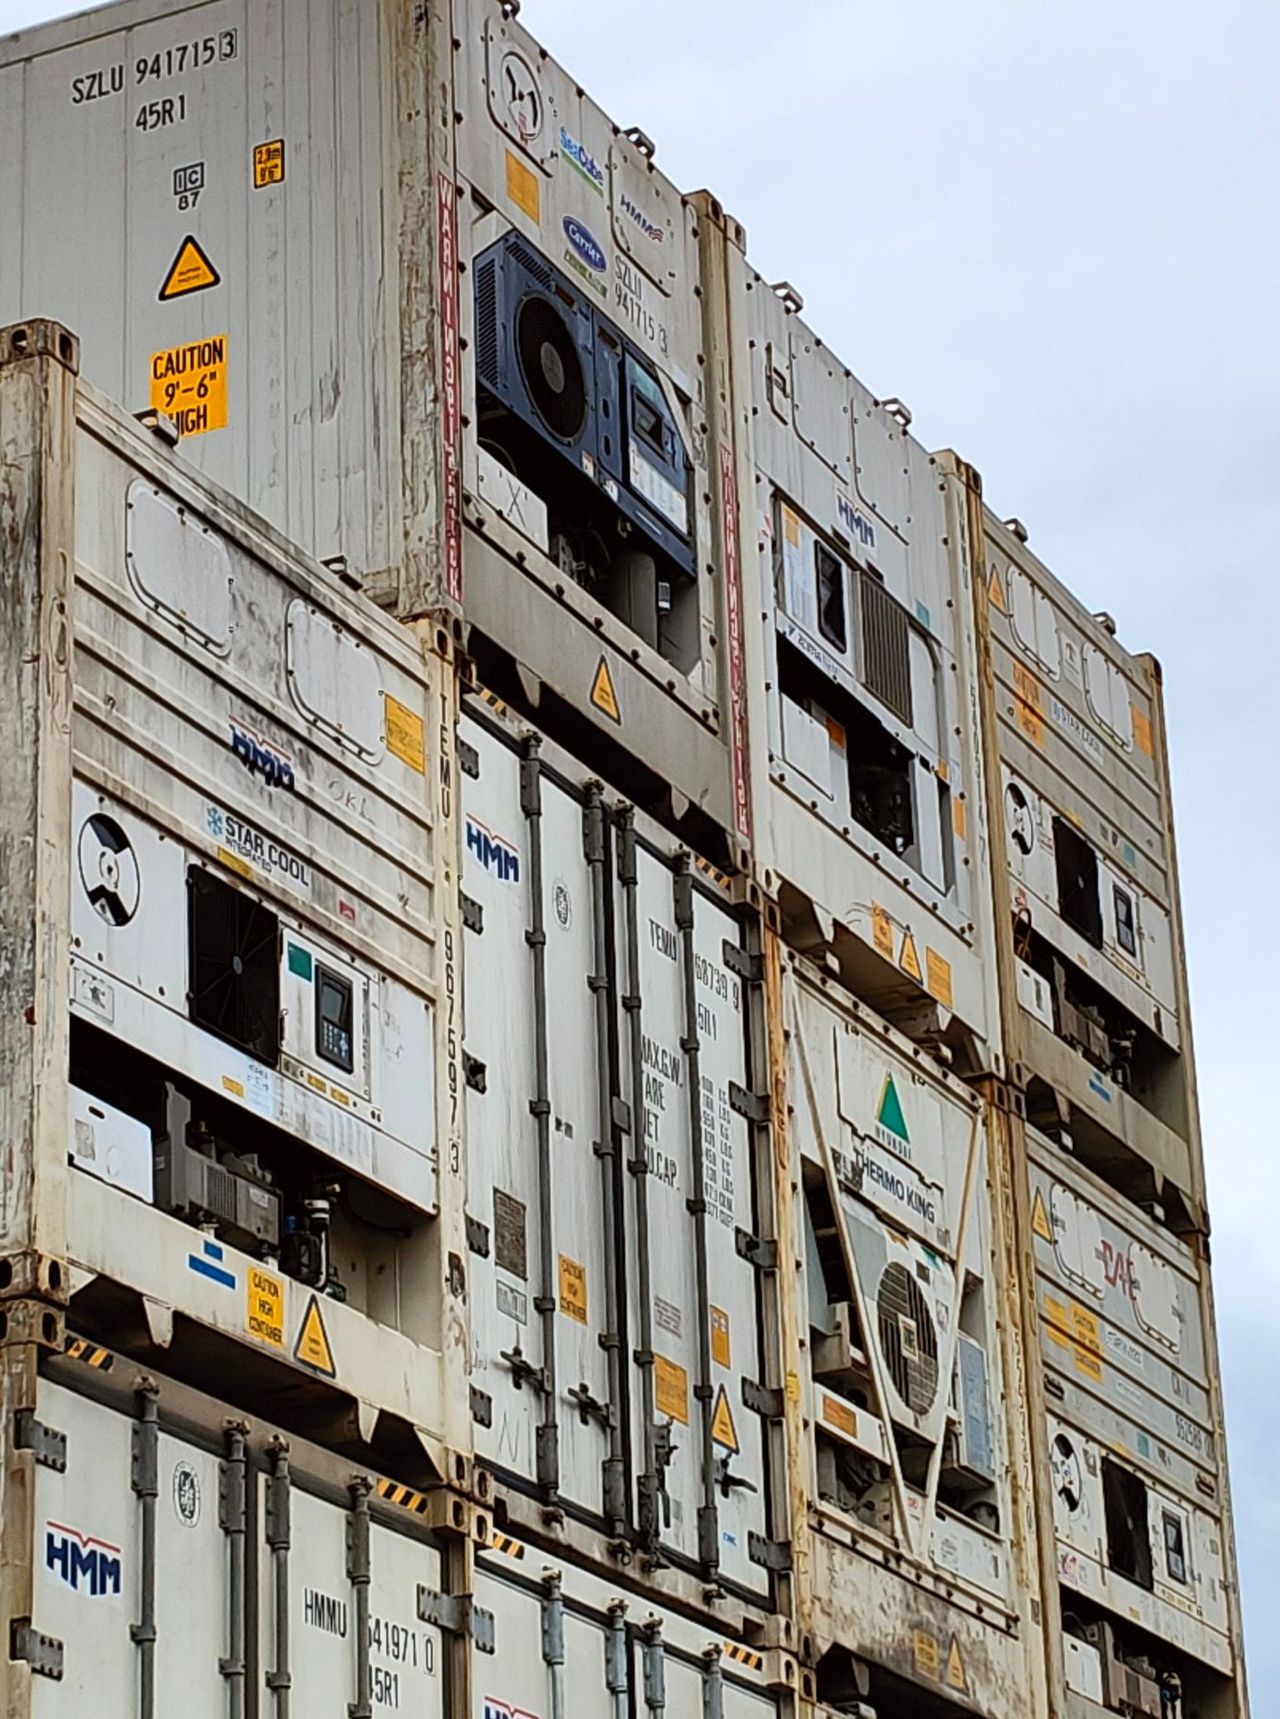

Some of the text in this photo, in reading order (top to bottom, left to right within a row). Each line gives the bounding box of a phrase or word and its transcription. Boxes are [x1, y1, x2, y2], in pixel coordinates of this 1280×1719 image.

[72, 31, 235, 103] SZLU 941715 3
[136, 95, 185, 131] 45R1
[178, 190, 200, 211] 87
[621, 193, 654, 237] HMM
[568, 224, 602, 264] Carrier
[438, 174, 455, 383] WARNING
[615, 255, 642, 300] SZLU
[615, 284, 655, 341] 941715
[153, 338, 223, 381] CAUTION
[837, 495, 875, 548] HMM
[440, 692, 451, 819] TEMU
[225, 816, 310, 887] STAR COOL
[225, 835, 273, 873] INTEGRATED
[467, 820, 519, 882] HMM
[648, 918, 677, 962] TEMU
[695, 952, 729, 1001] 68739
[445, 929, 459, 1127] 967597
[645, 1072, 666, 1111] ARE
[643, 1106, 660, 1142] ET
[853, 1147, 905, 1201] THERMO
[906, 1185, 935, 1225] KING
[253, 1272, 279, 1299] CAUTION
[248, 1315, 282, 1344] CONTAINER
[46, 1532, 121, 1596] HMM
[303, 1588, 347, 1639] HMMU
[425, 1636, 434, 1674] 0
[368, 1664, 399, 1710] 5R1
